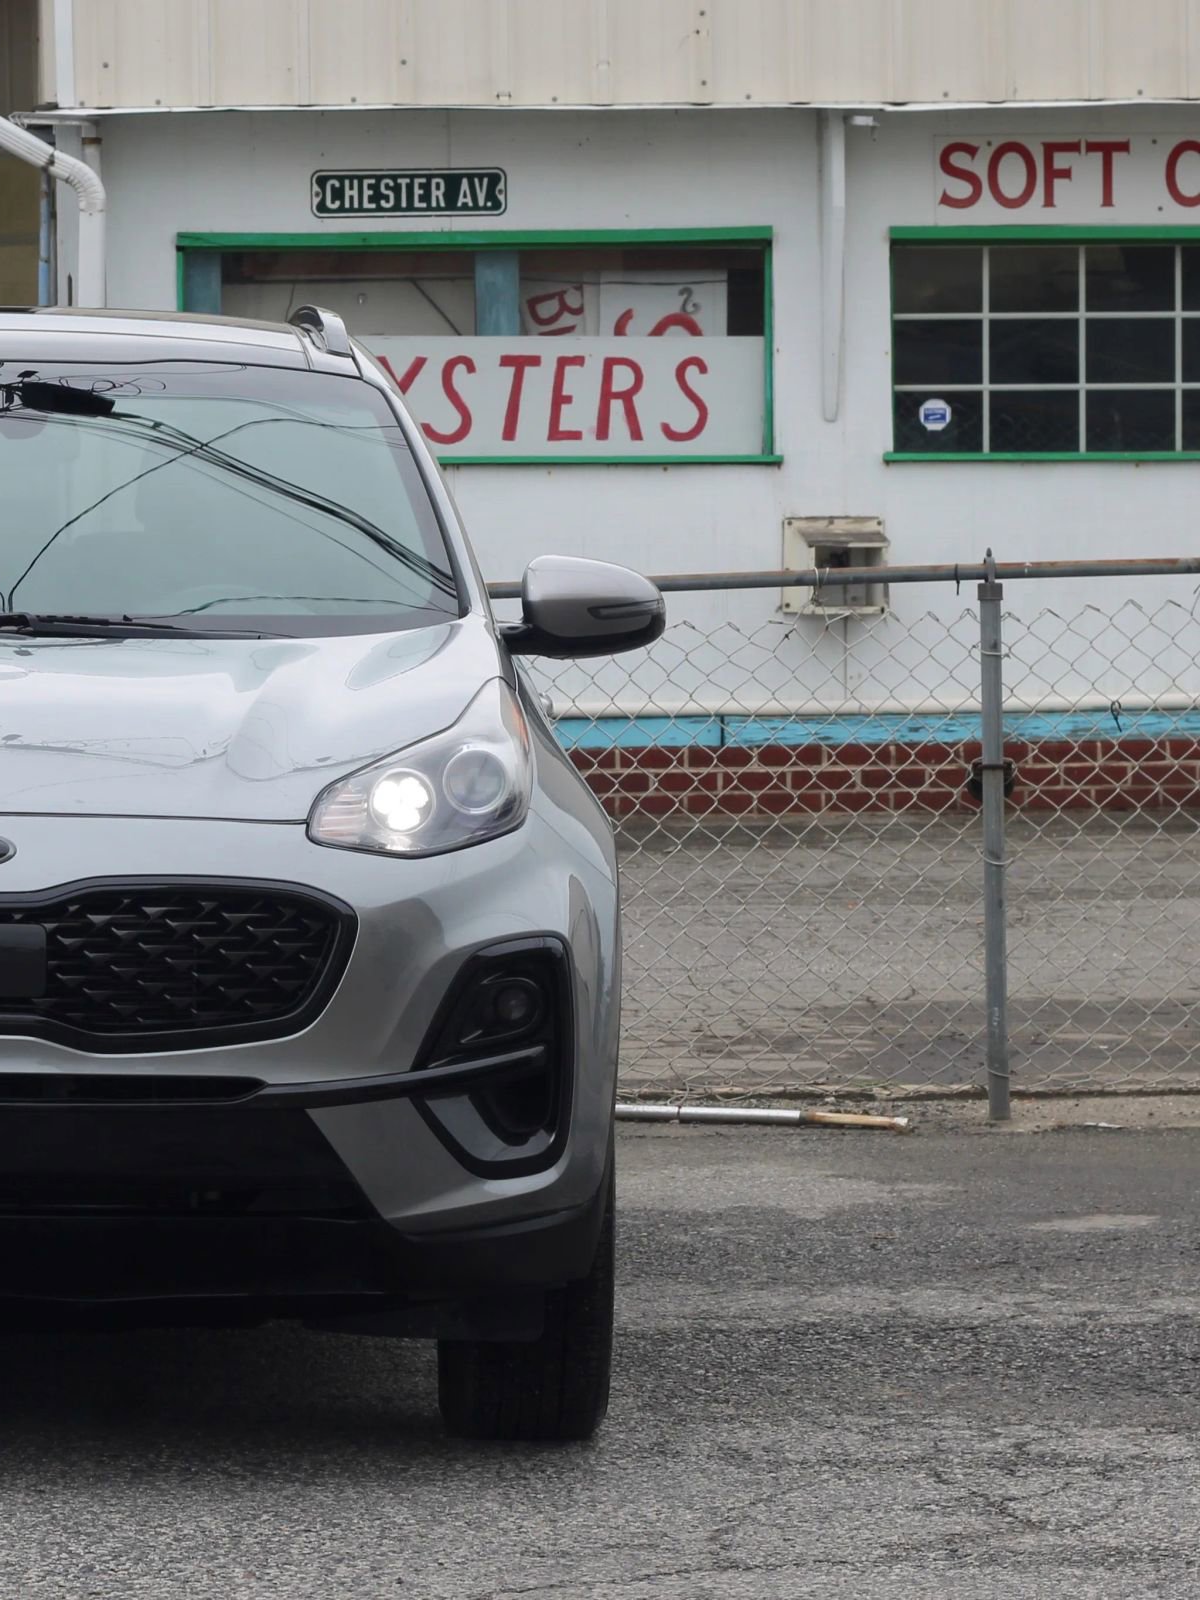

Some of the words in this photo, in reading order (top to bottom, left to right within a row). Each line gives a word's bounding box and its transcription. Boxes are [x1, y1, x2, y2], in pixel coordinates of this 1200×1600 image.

[325, 177, 446, 209] CHESTER
[457, 177, 493, 208] AV.
[938, 138, 1130, 209] SOFT
